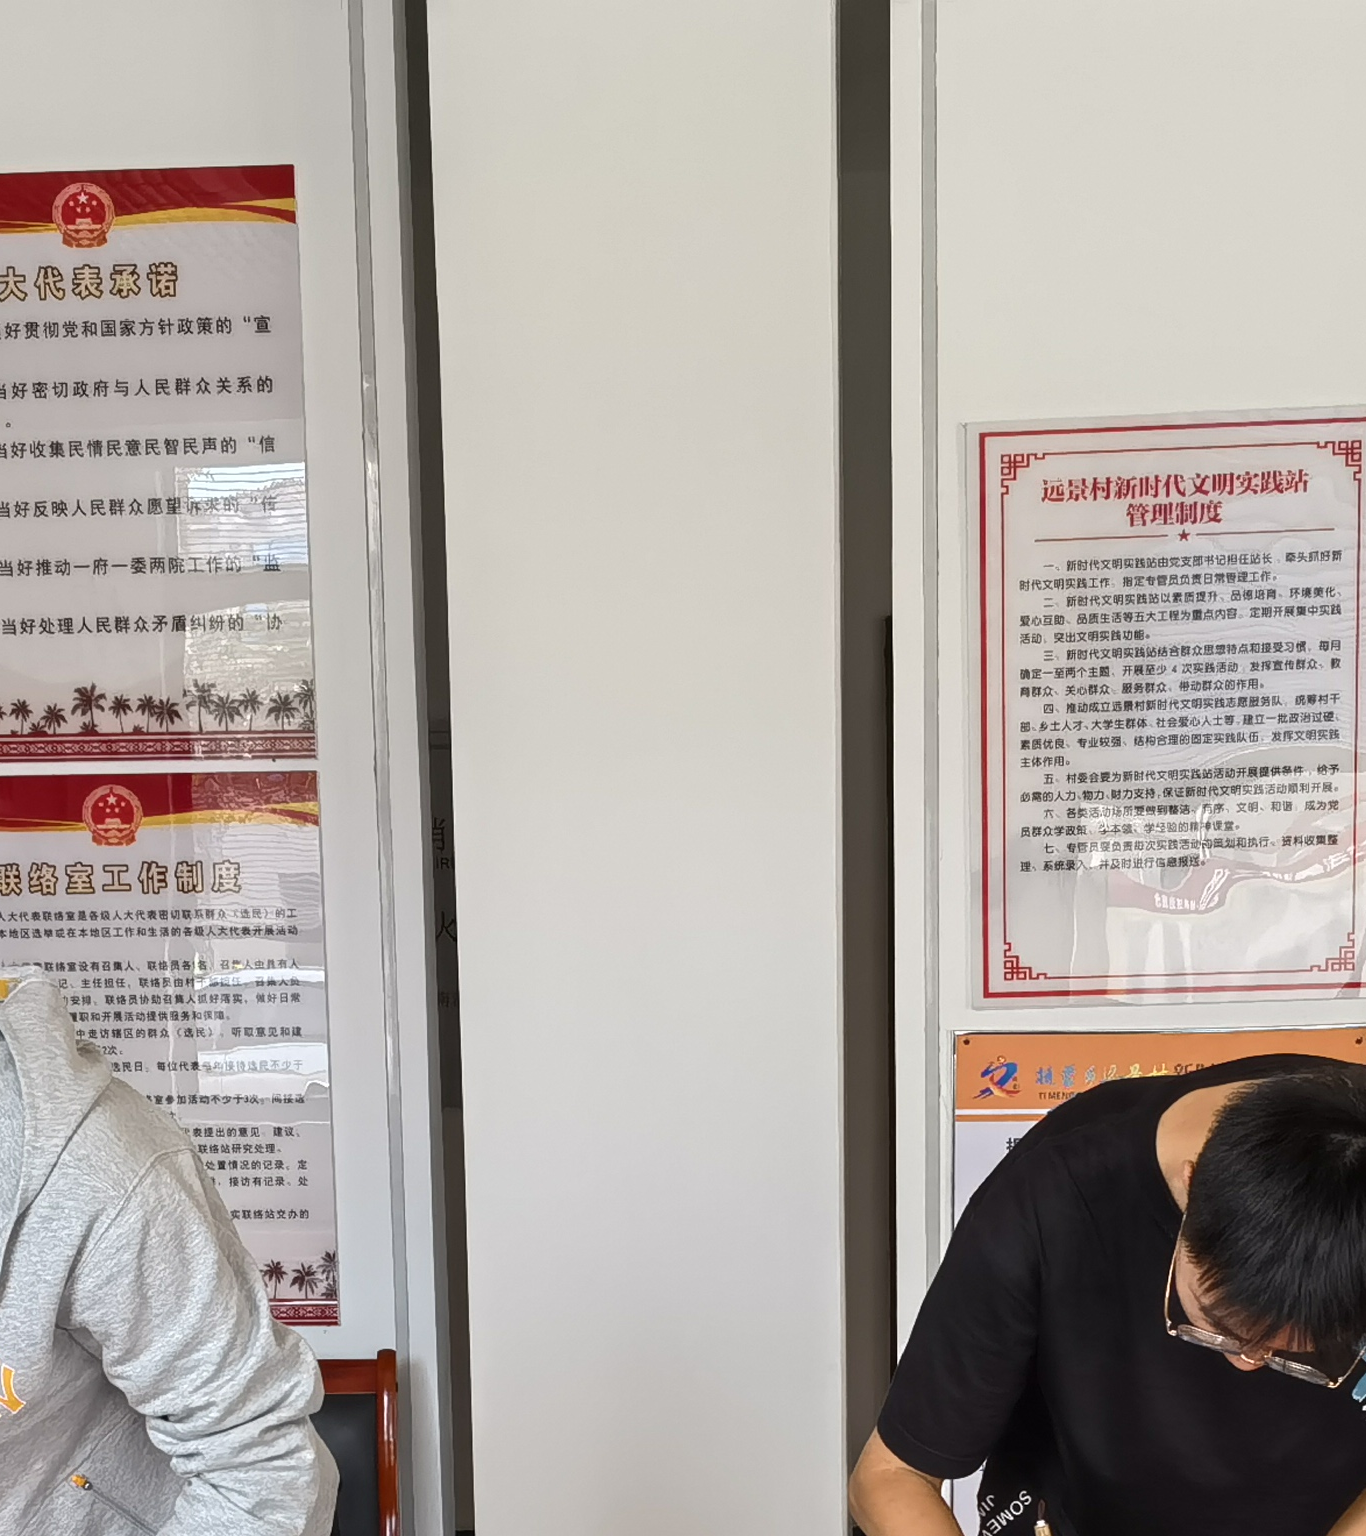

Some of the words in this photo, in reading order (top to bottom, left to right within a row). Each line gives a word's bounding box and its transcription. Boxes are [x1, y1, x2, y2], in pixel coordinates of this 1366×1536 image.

[1041, 469, 1309, 504] 远景村新时代文明实践站
[1126, 502, 1223, 528] 管理制度
